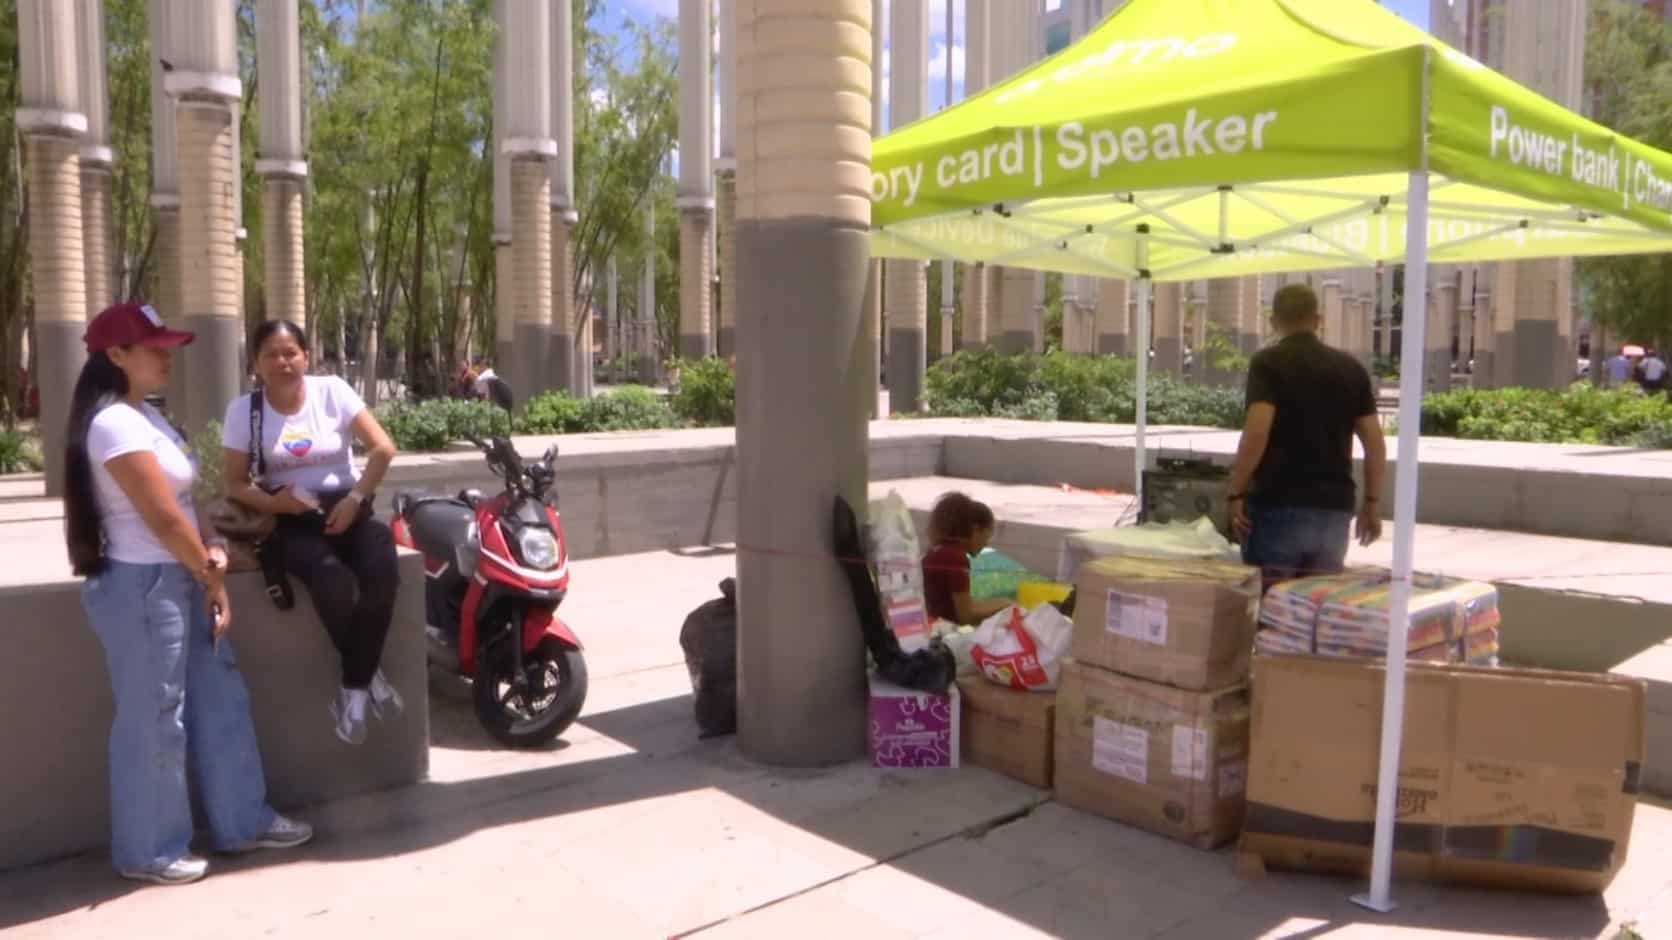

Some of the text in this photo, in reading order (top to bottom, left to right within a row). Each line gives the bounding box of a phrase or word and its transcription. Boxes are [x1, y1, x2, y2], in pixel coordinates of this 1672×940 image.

[936, 129, 1024, 187] card
[1056, 108, 1278, 177] Speaker
[1491, 106, 1567, 176] Power
[1572, 132, 1618, 192] bank
